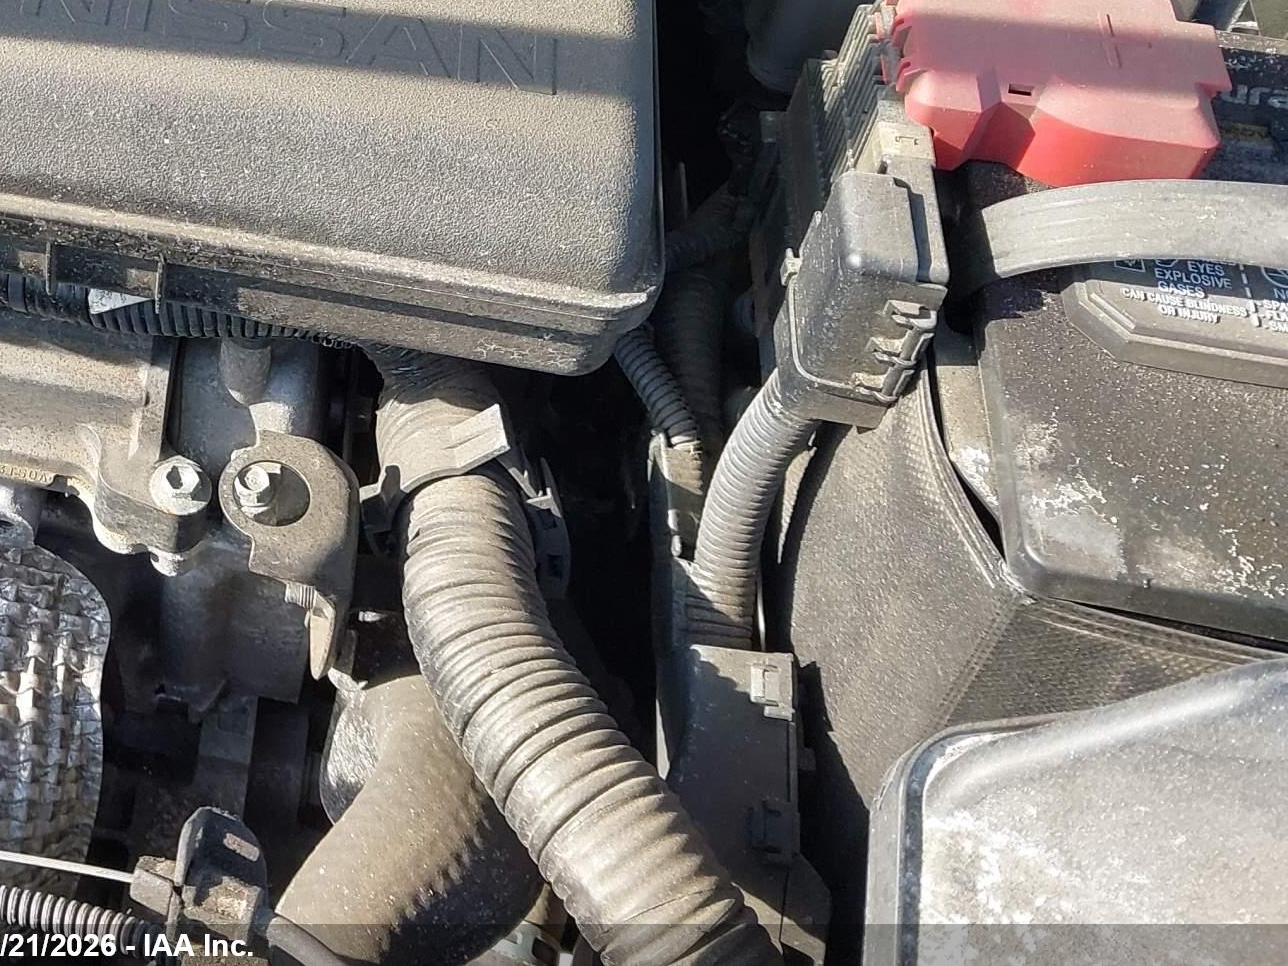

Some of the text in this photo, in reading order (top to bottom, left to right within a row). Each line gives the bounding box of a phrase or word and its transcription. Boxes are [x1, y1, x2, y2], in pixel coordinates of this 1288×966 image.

[1154, 267, 1233, 290] EXPLOSIVE
[1187, 261, 1225, 277] EYES
[1157, 280, 1205, 299] GASES
[1122, 288, 1248, 317] CAN CAUSE BLINDNESS
[1159, 305, 1219, 323] OR INJURY
